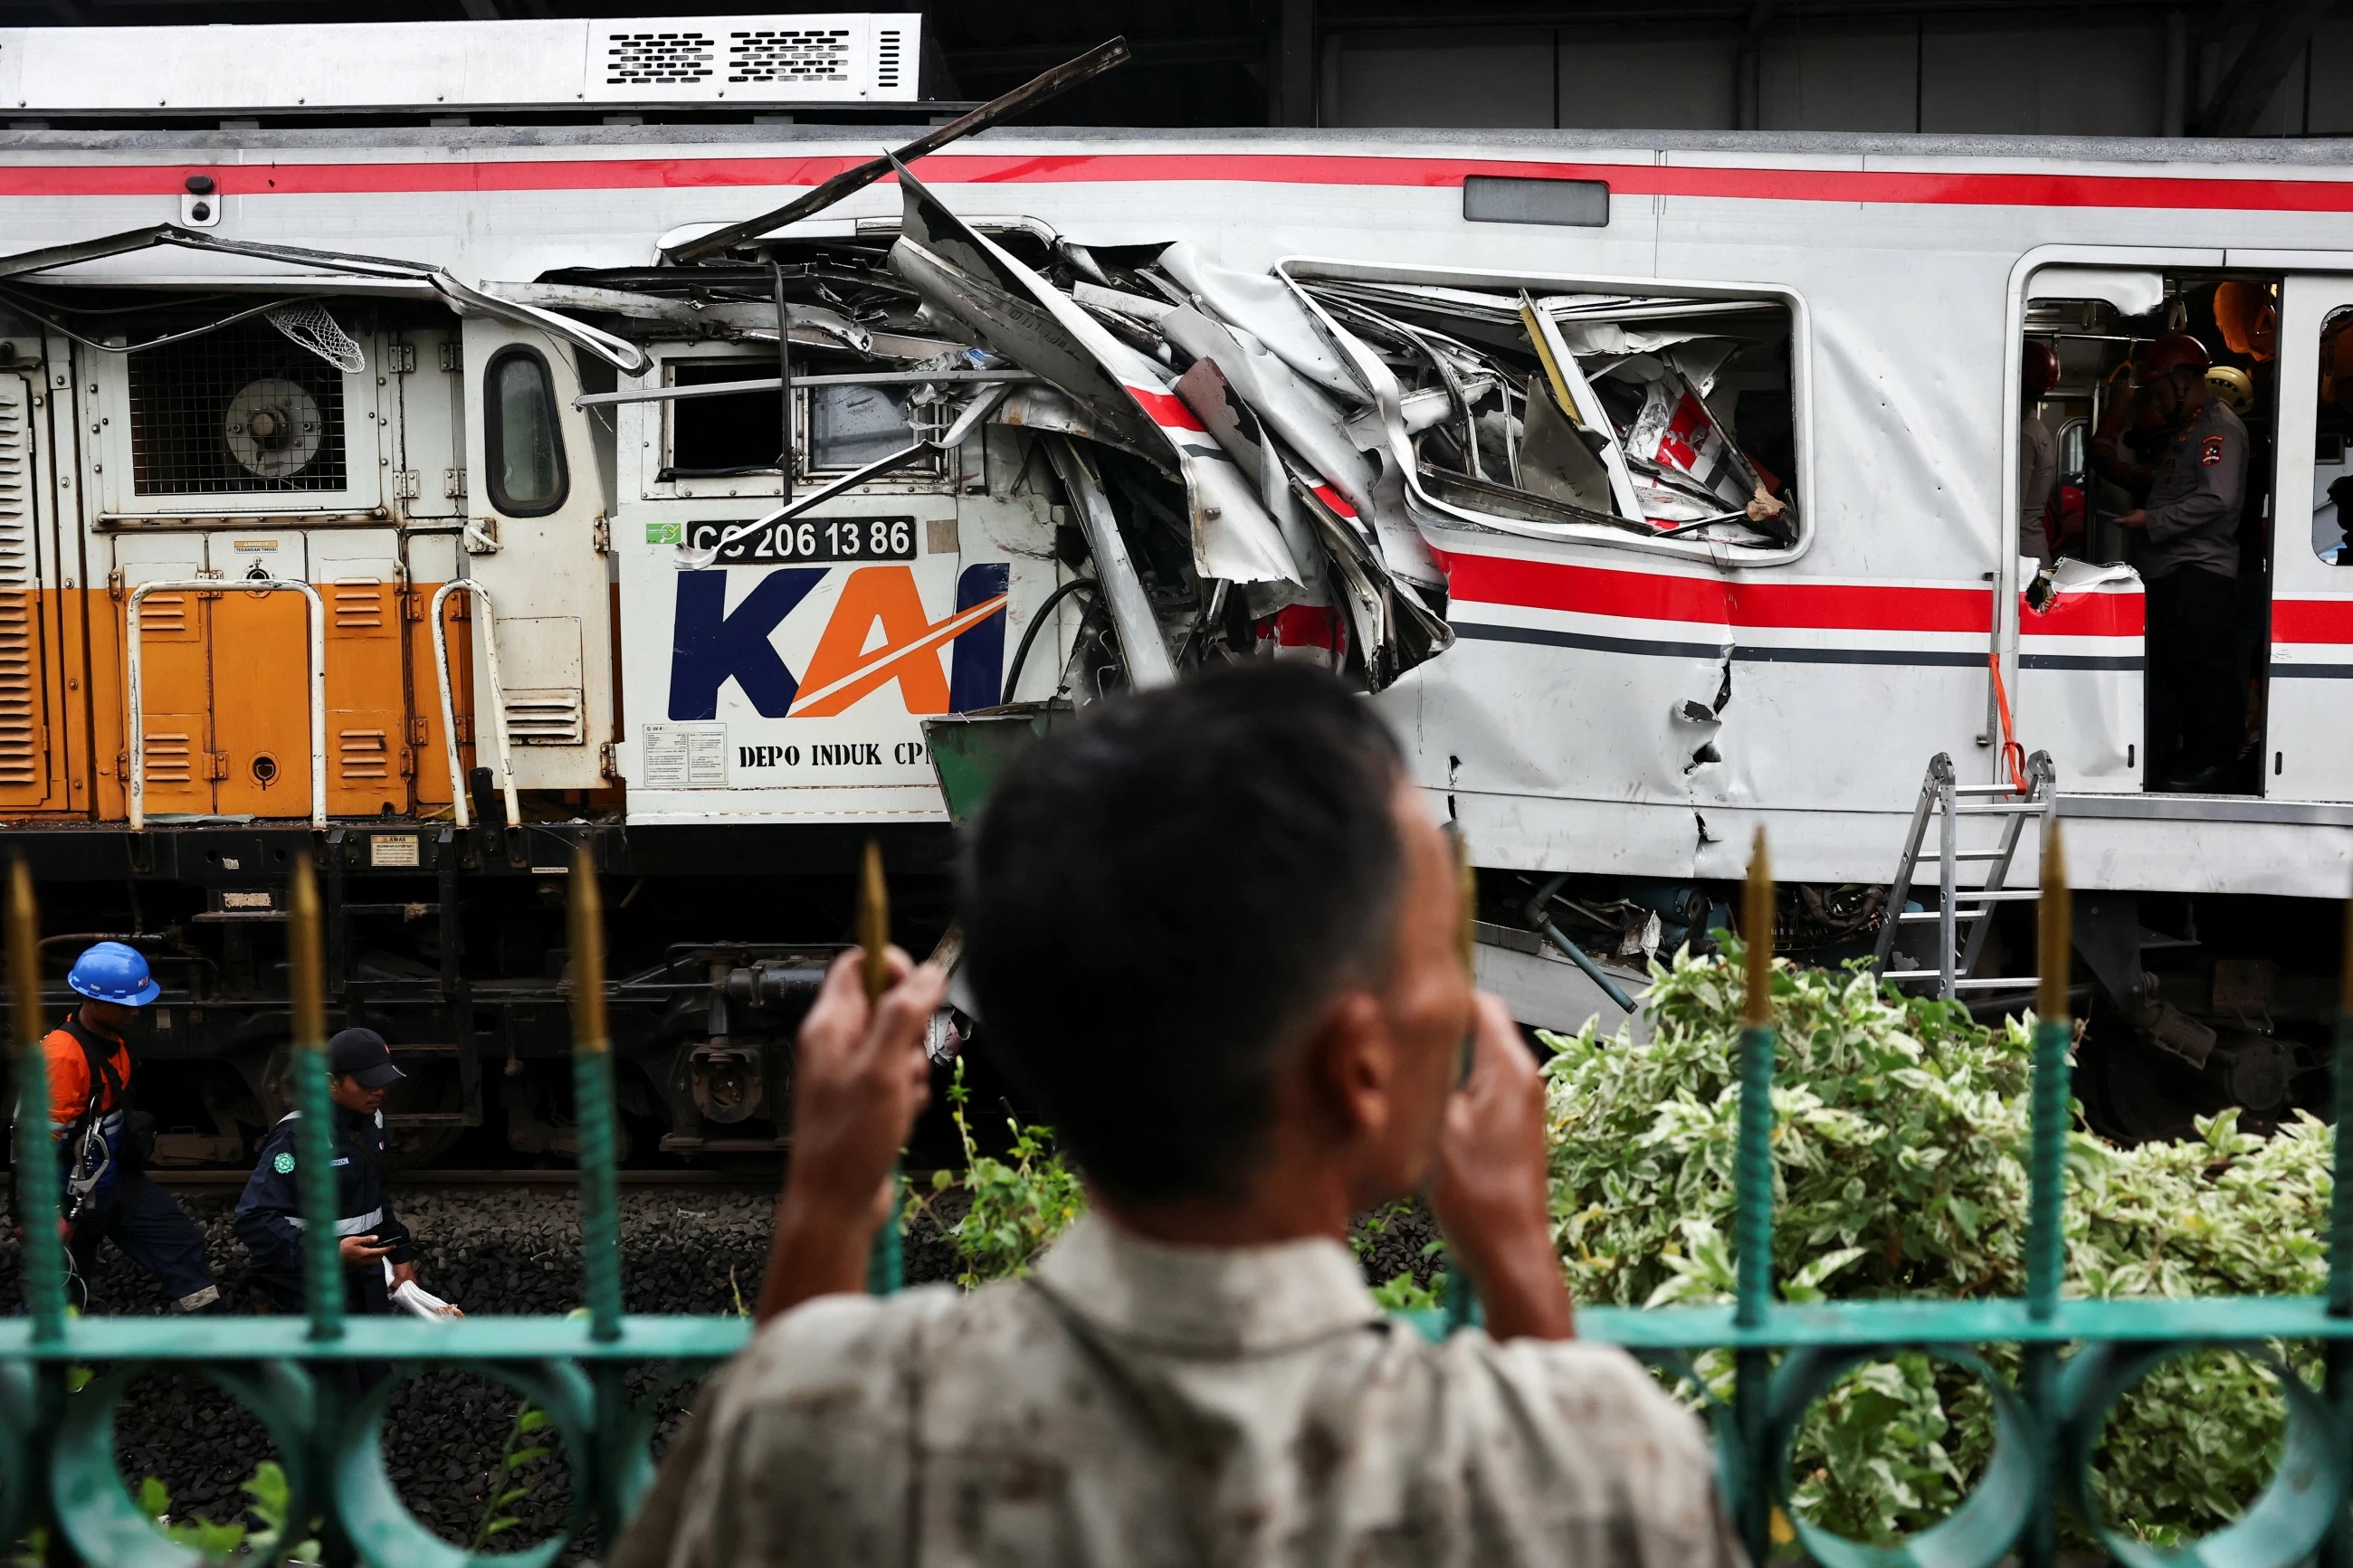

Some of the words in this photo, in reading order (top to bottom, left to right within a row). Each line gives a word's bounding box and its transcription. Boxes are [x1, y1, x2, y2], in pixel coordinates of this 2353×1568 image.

[755, 523, 815, 556] 206
[824, 522, 861, 556] 13
[870, 521, 910, 554] 86
[668, 562, 1010, 721] KAI
[738, 746, 800, 767] DEPO
[812, 744, 882, 766] INDUK
